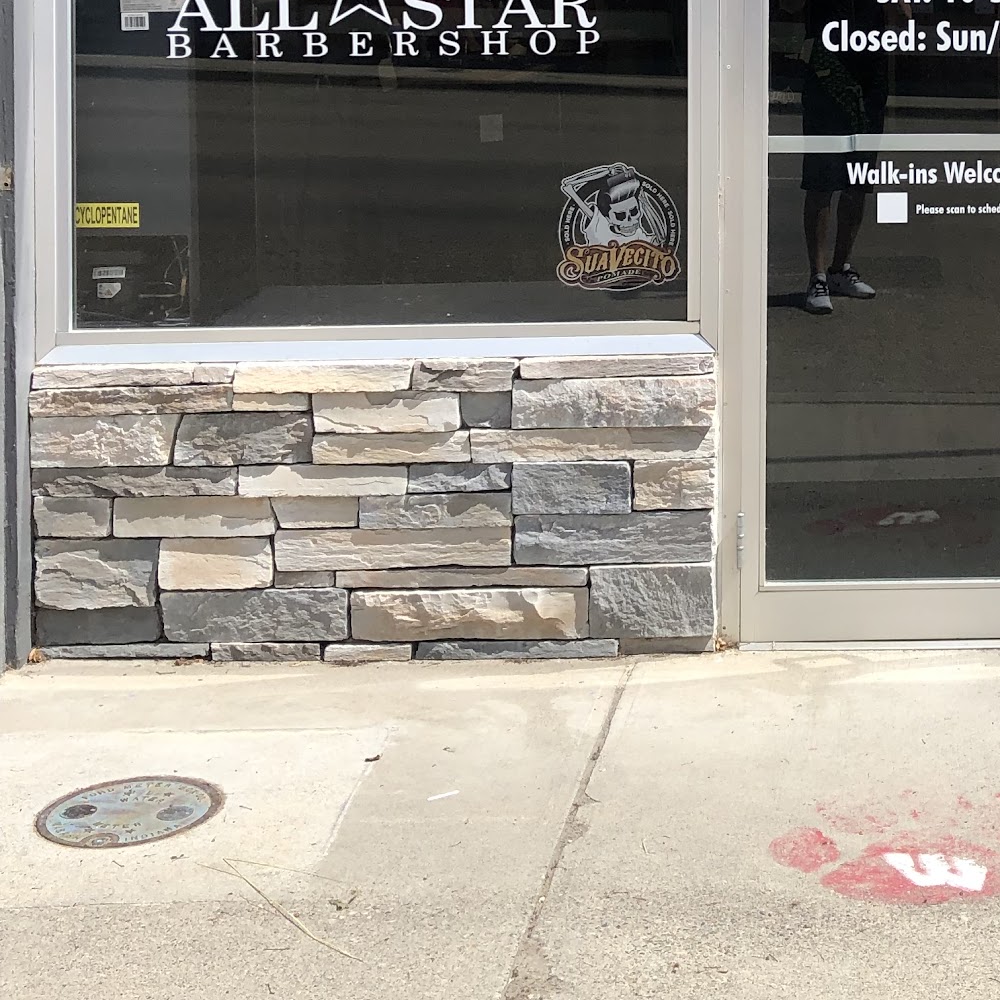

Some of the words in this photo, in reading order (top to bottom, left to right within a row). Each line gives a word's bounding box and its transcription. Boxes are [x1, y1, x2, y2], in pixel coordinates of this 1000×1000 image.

[165, 29, 601, 59] BARBERSHOP
[821, 19, 927, 52] Closed:
[846, 160, 938, 185] Walk-ins
[76, 206, 138, 225] CYCLOPENTANE
[915, 204, 945, 215] Please
[946, 205, 966, 215] scan
[967, 204, 977, 214] to
